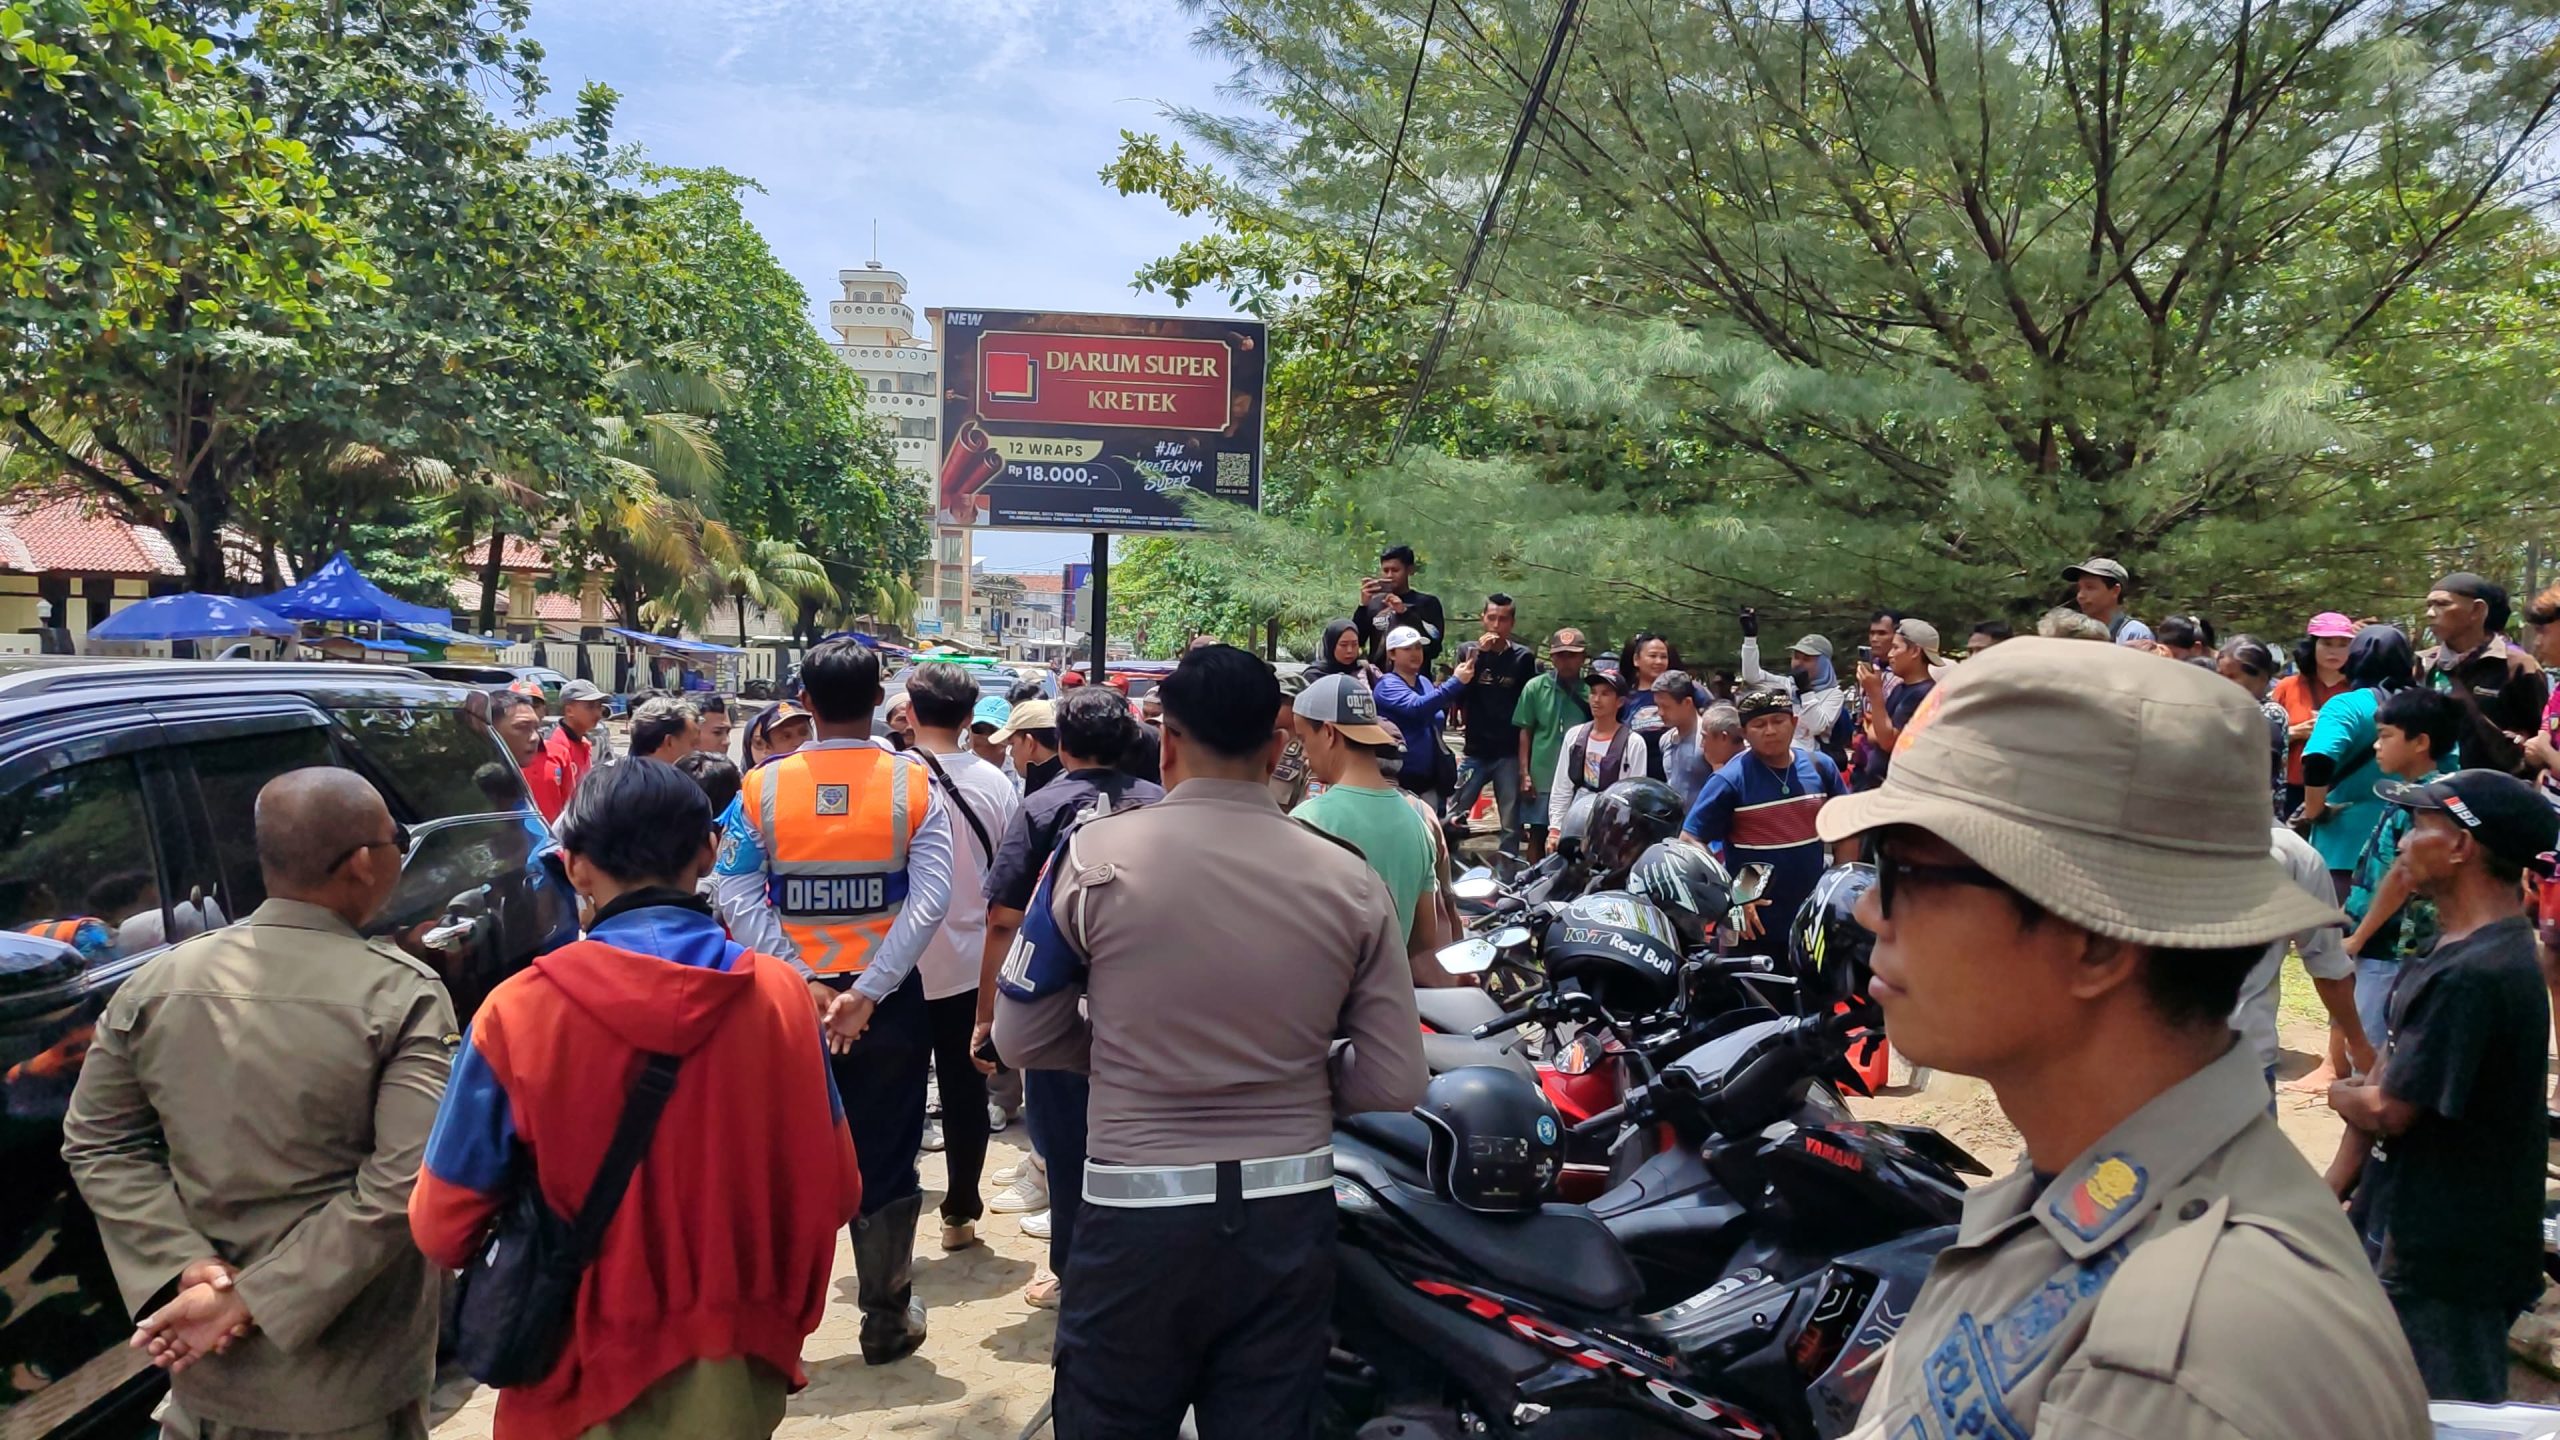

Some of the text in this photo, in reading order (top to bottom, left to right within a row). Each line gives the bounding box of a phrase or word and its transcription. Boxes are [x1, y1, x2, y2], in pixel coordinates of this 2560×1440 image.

[947, 312, 983, 326] NEW
[1046, 351, 1220, 377] DJARUM SUPER
[1088, 390, 1177, 413] KRETEK
[1009, 442, 1083, 456] 12 WRAPS
[1008, 465, 1099, 486] Rp 18.000,-
[1144, 475, 1191, 492] SUPER
[787, 877, 883, 911] DISHUB
[1563, 927, 1673, 976] KYT Red Bull
[1805, 1136, 1863, 1173] YAMAHA
